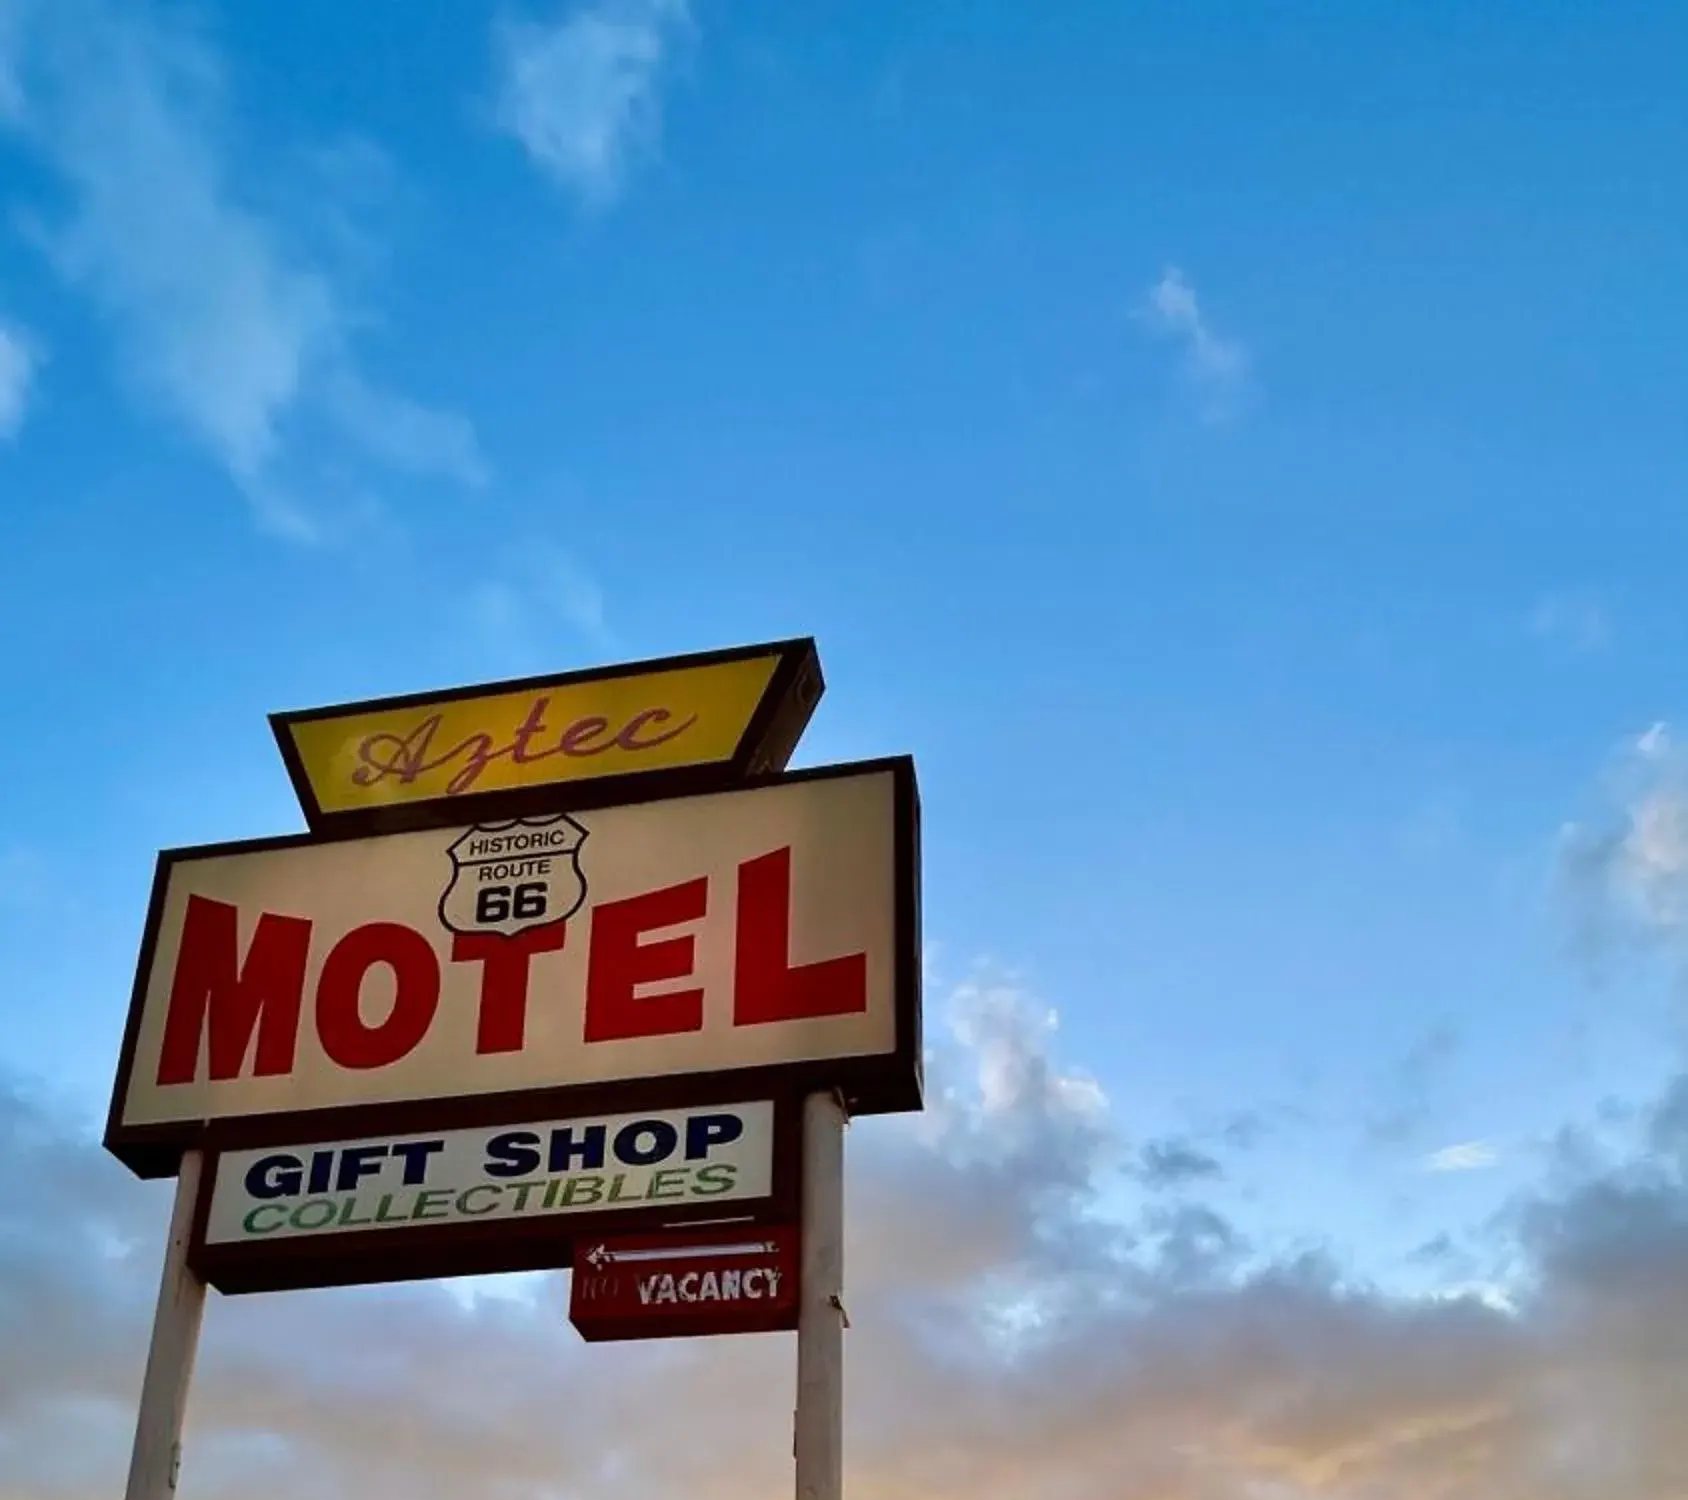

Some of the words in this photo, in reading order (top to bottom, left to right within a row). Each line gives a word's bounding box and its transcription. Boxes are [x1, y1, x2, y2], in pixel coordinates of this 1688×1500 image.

[352, 697, 697, 795] Aztec
[469, 829, 565, 857] HISTORIC
[478, 859, 551, 882] ROUTE
[476, 881, 548, 923] 66
[156, 845, 867, 1086] MOTEL
[244, 1140, 444, 1199] GIFT
[484, 1113, 744, 1177] SHOP
[242, 1163, 738, 1234] COLLECTIBLES
[637, 1266, 783, 1305] VACANCY
